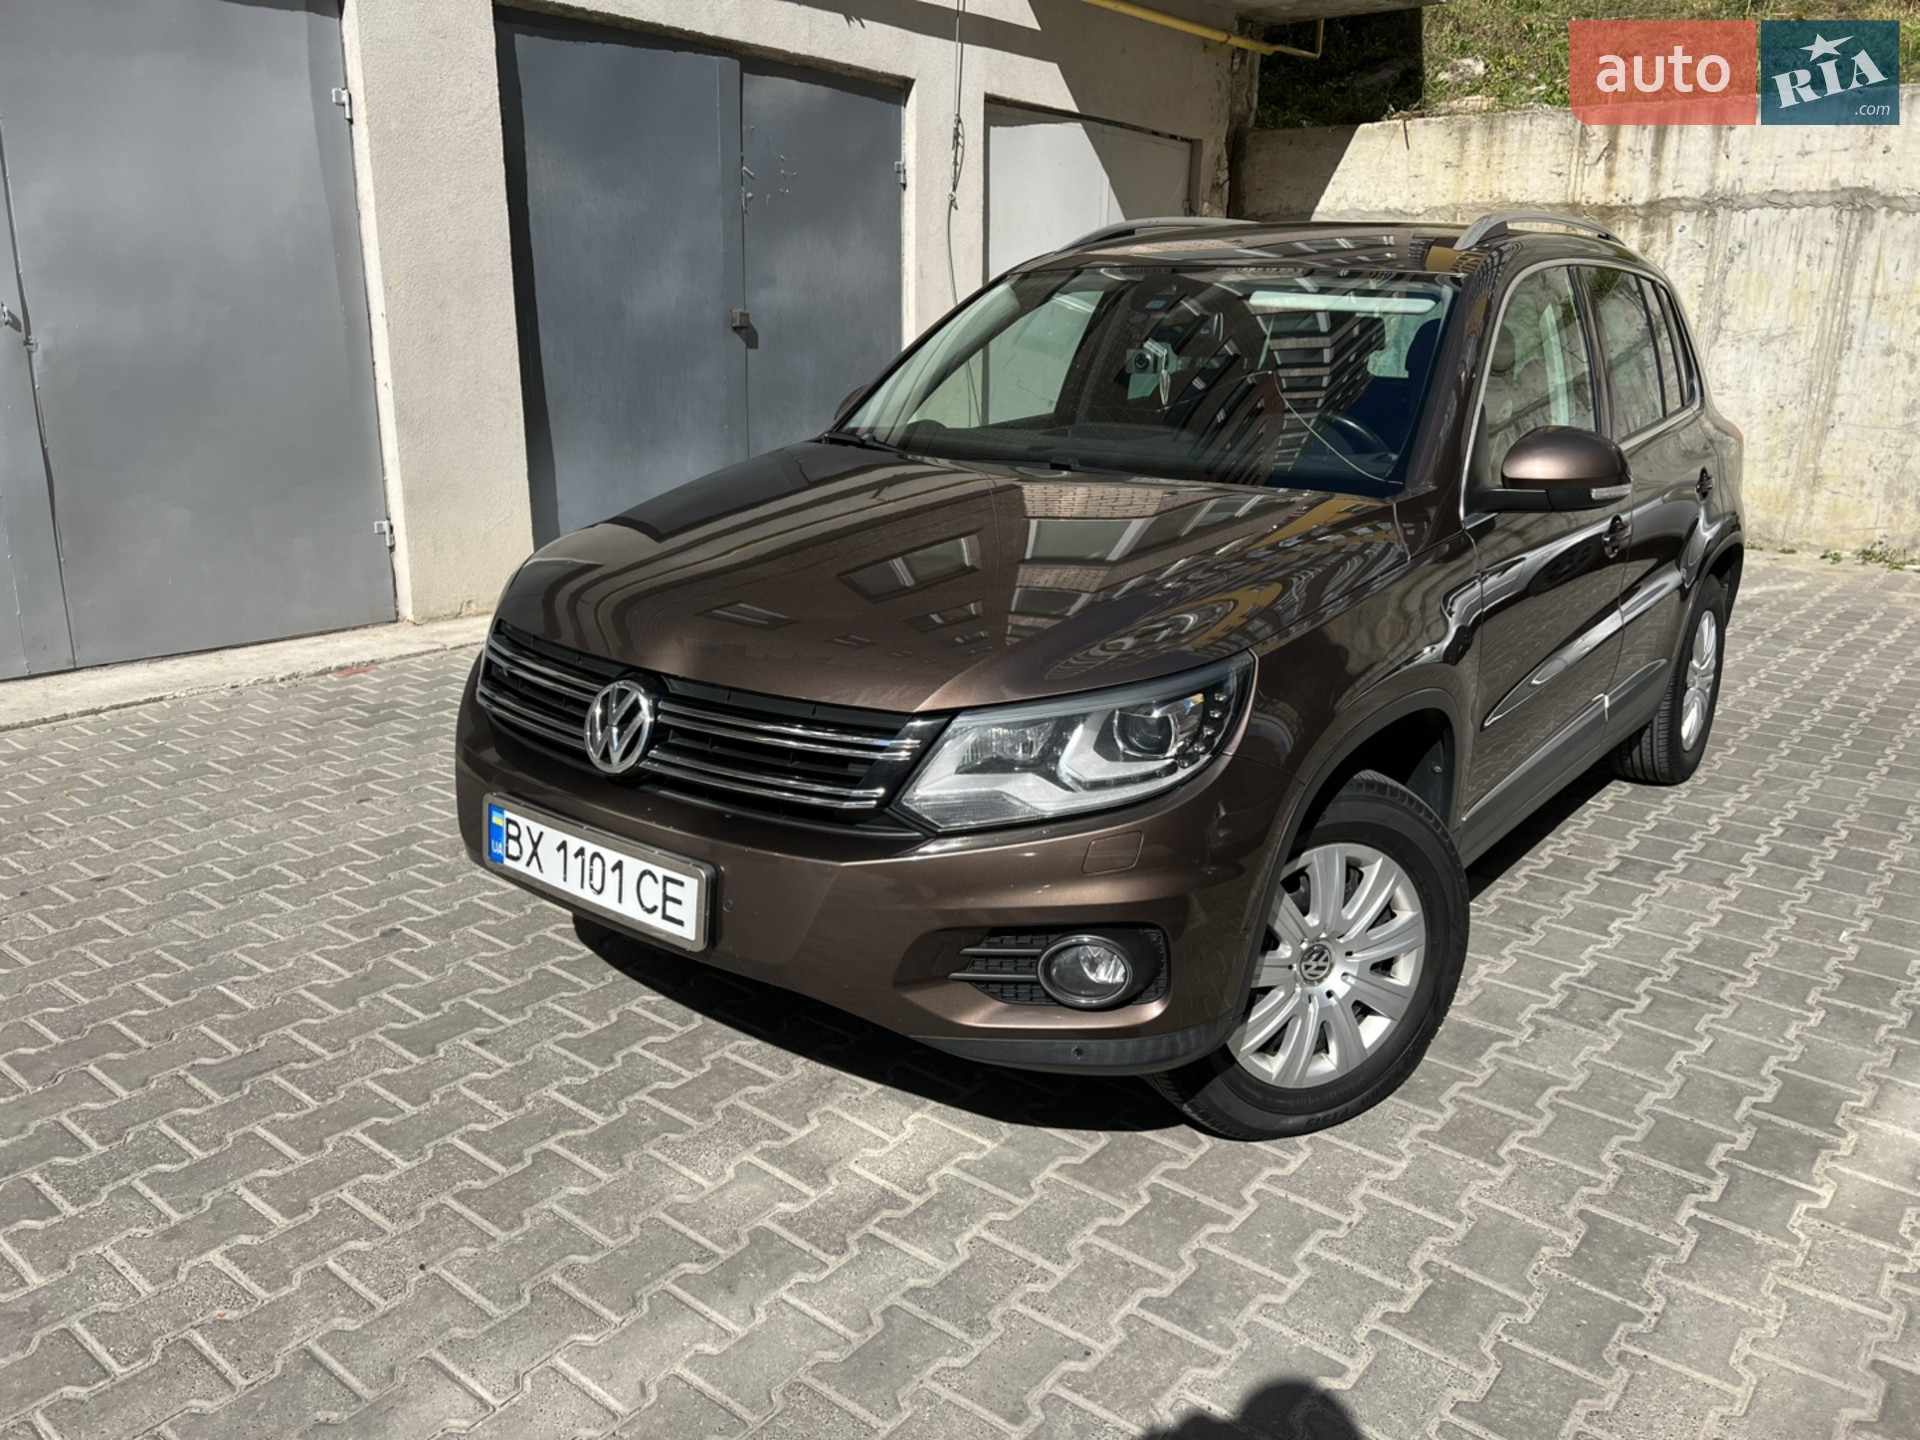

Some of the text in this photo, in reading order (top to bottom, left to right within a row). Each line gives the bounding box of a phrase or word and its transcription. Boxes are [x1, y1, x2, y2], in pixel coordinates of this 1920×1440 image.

[491, 839, 505, 856] UA
[505, 817, 685, 927] BX 1101 CE
